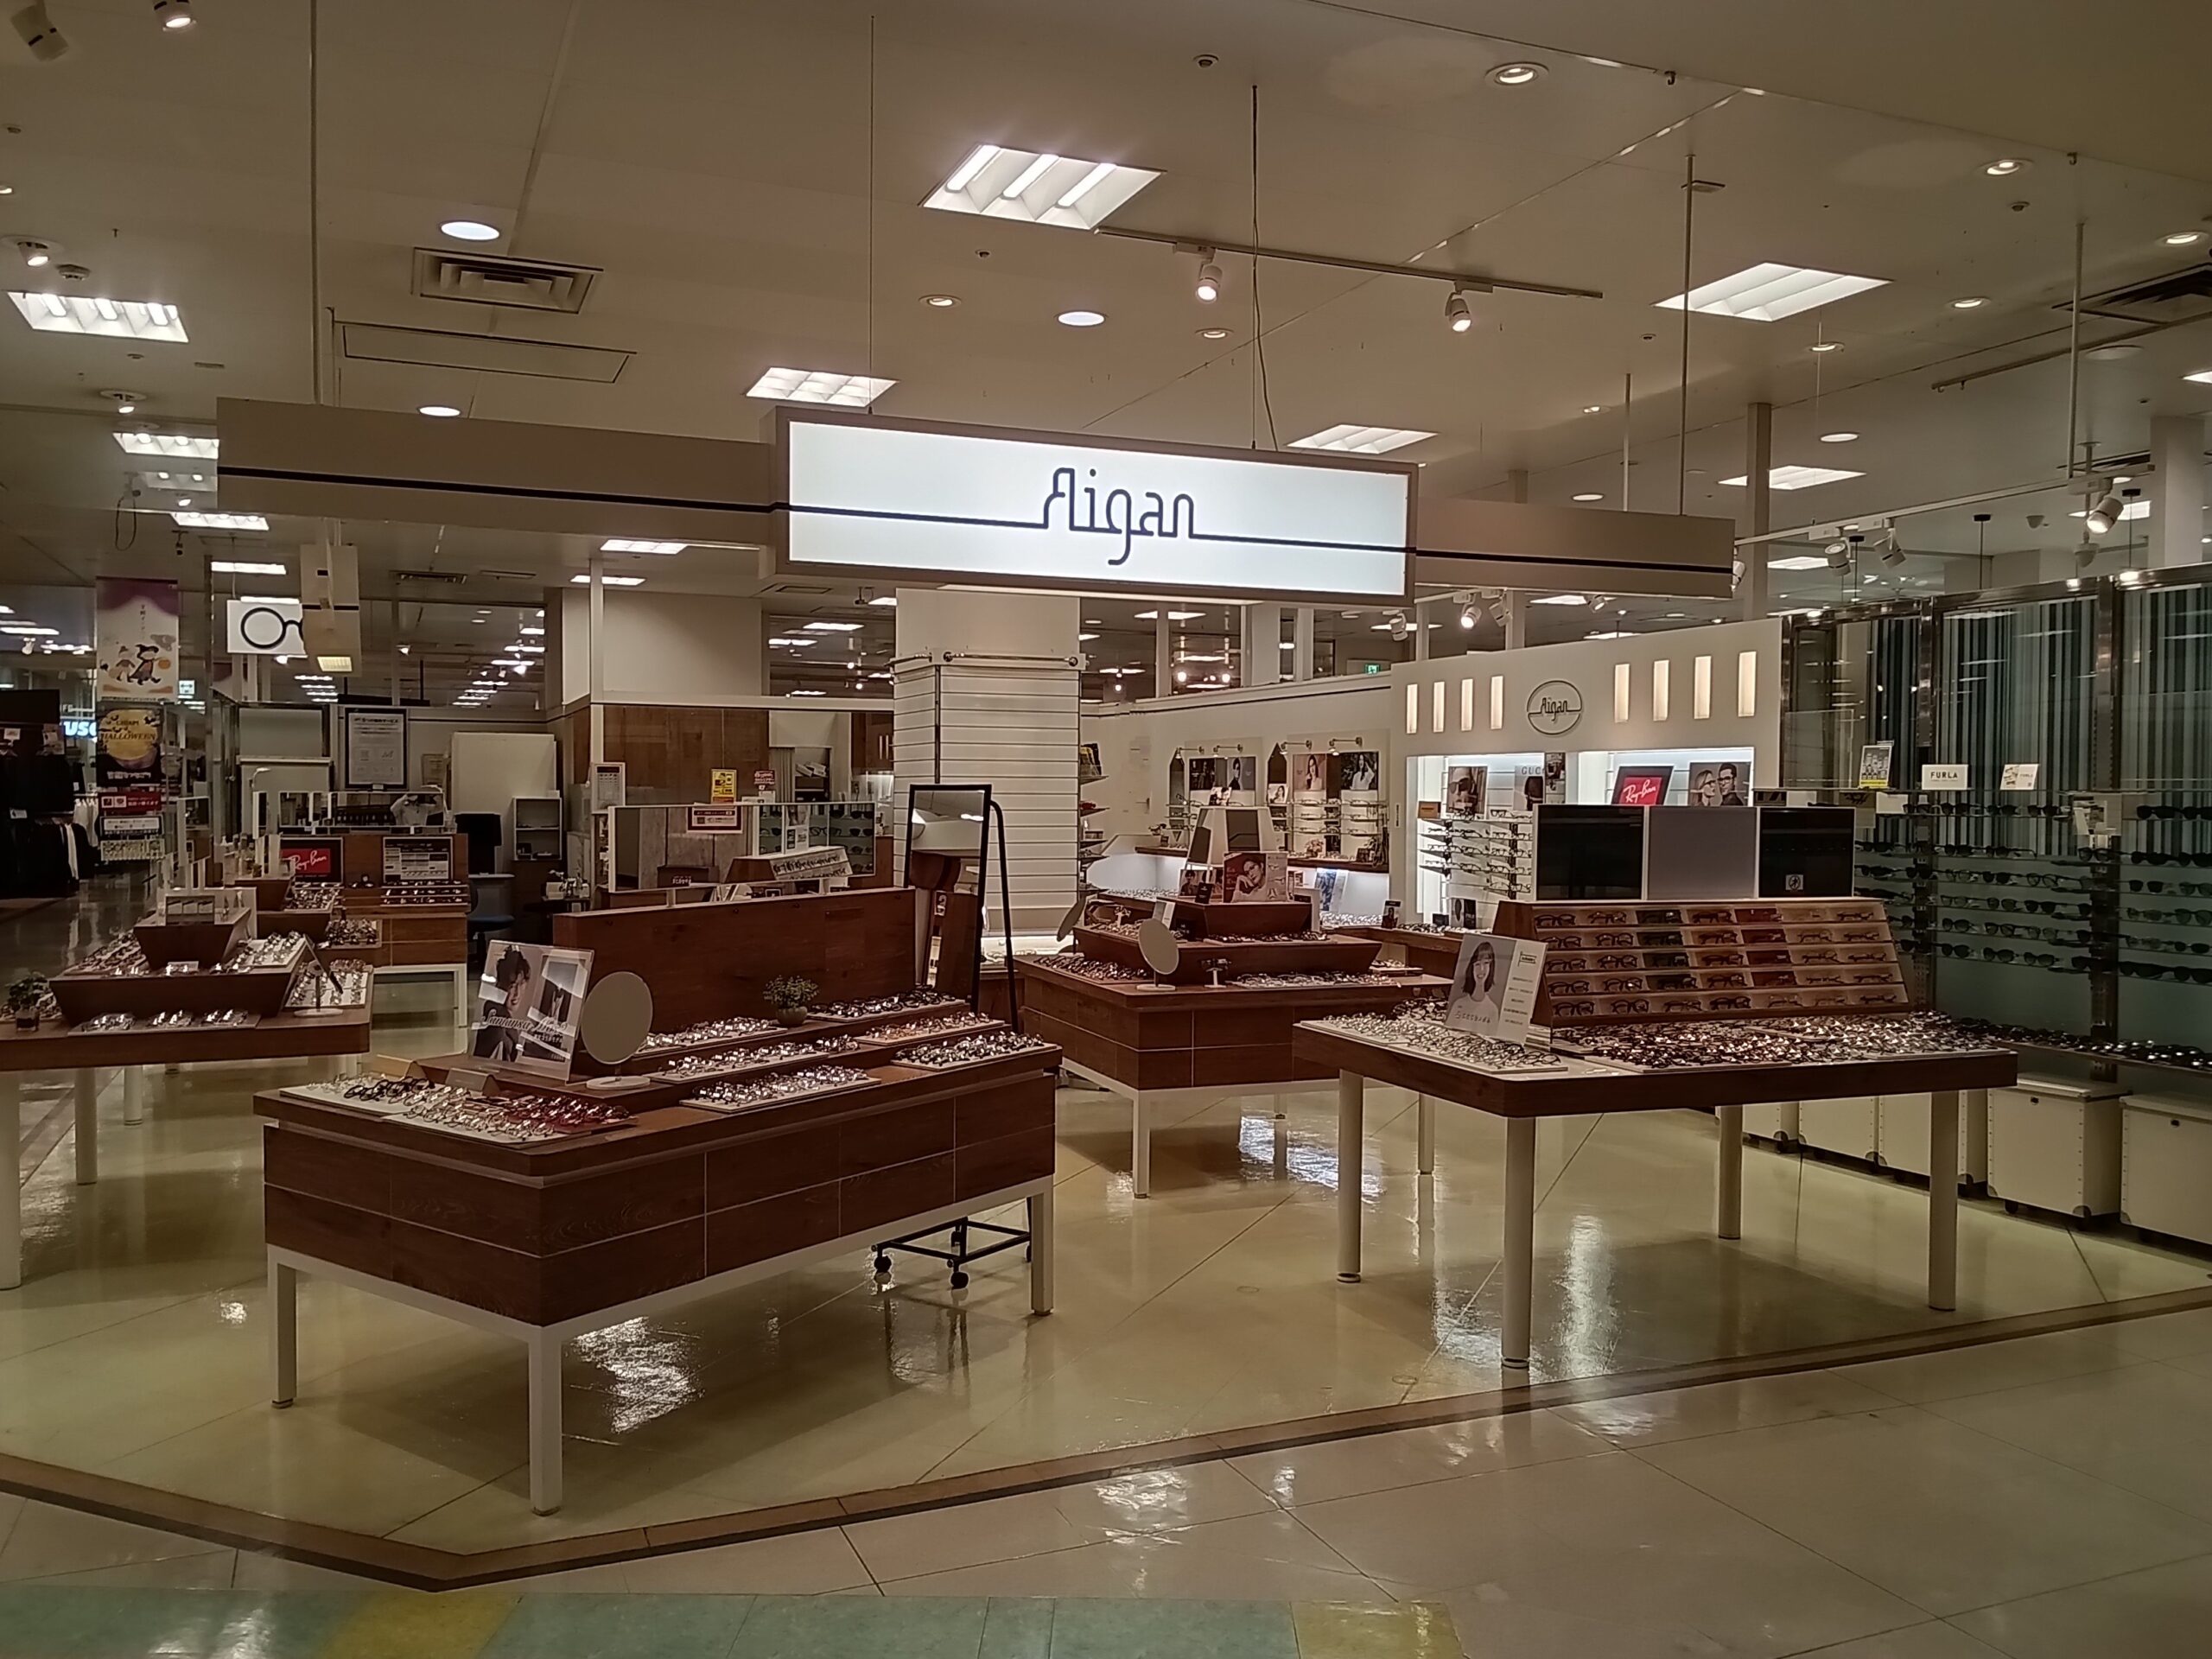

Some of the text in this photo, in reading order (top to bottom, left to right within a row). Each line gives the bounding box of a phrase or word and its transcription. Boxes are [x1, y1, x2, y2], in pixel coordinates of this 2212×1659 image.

[1044, 467, 1194, 566] Aigan
[1540, 696, 1568, 721] Aigan
[1521, 766, 1545, 775] GUC
[1930, 771, 1958, 779] FURLA
[1623, 779, 1656, 804] Ray-Ban
